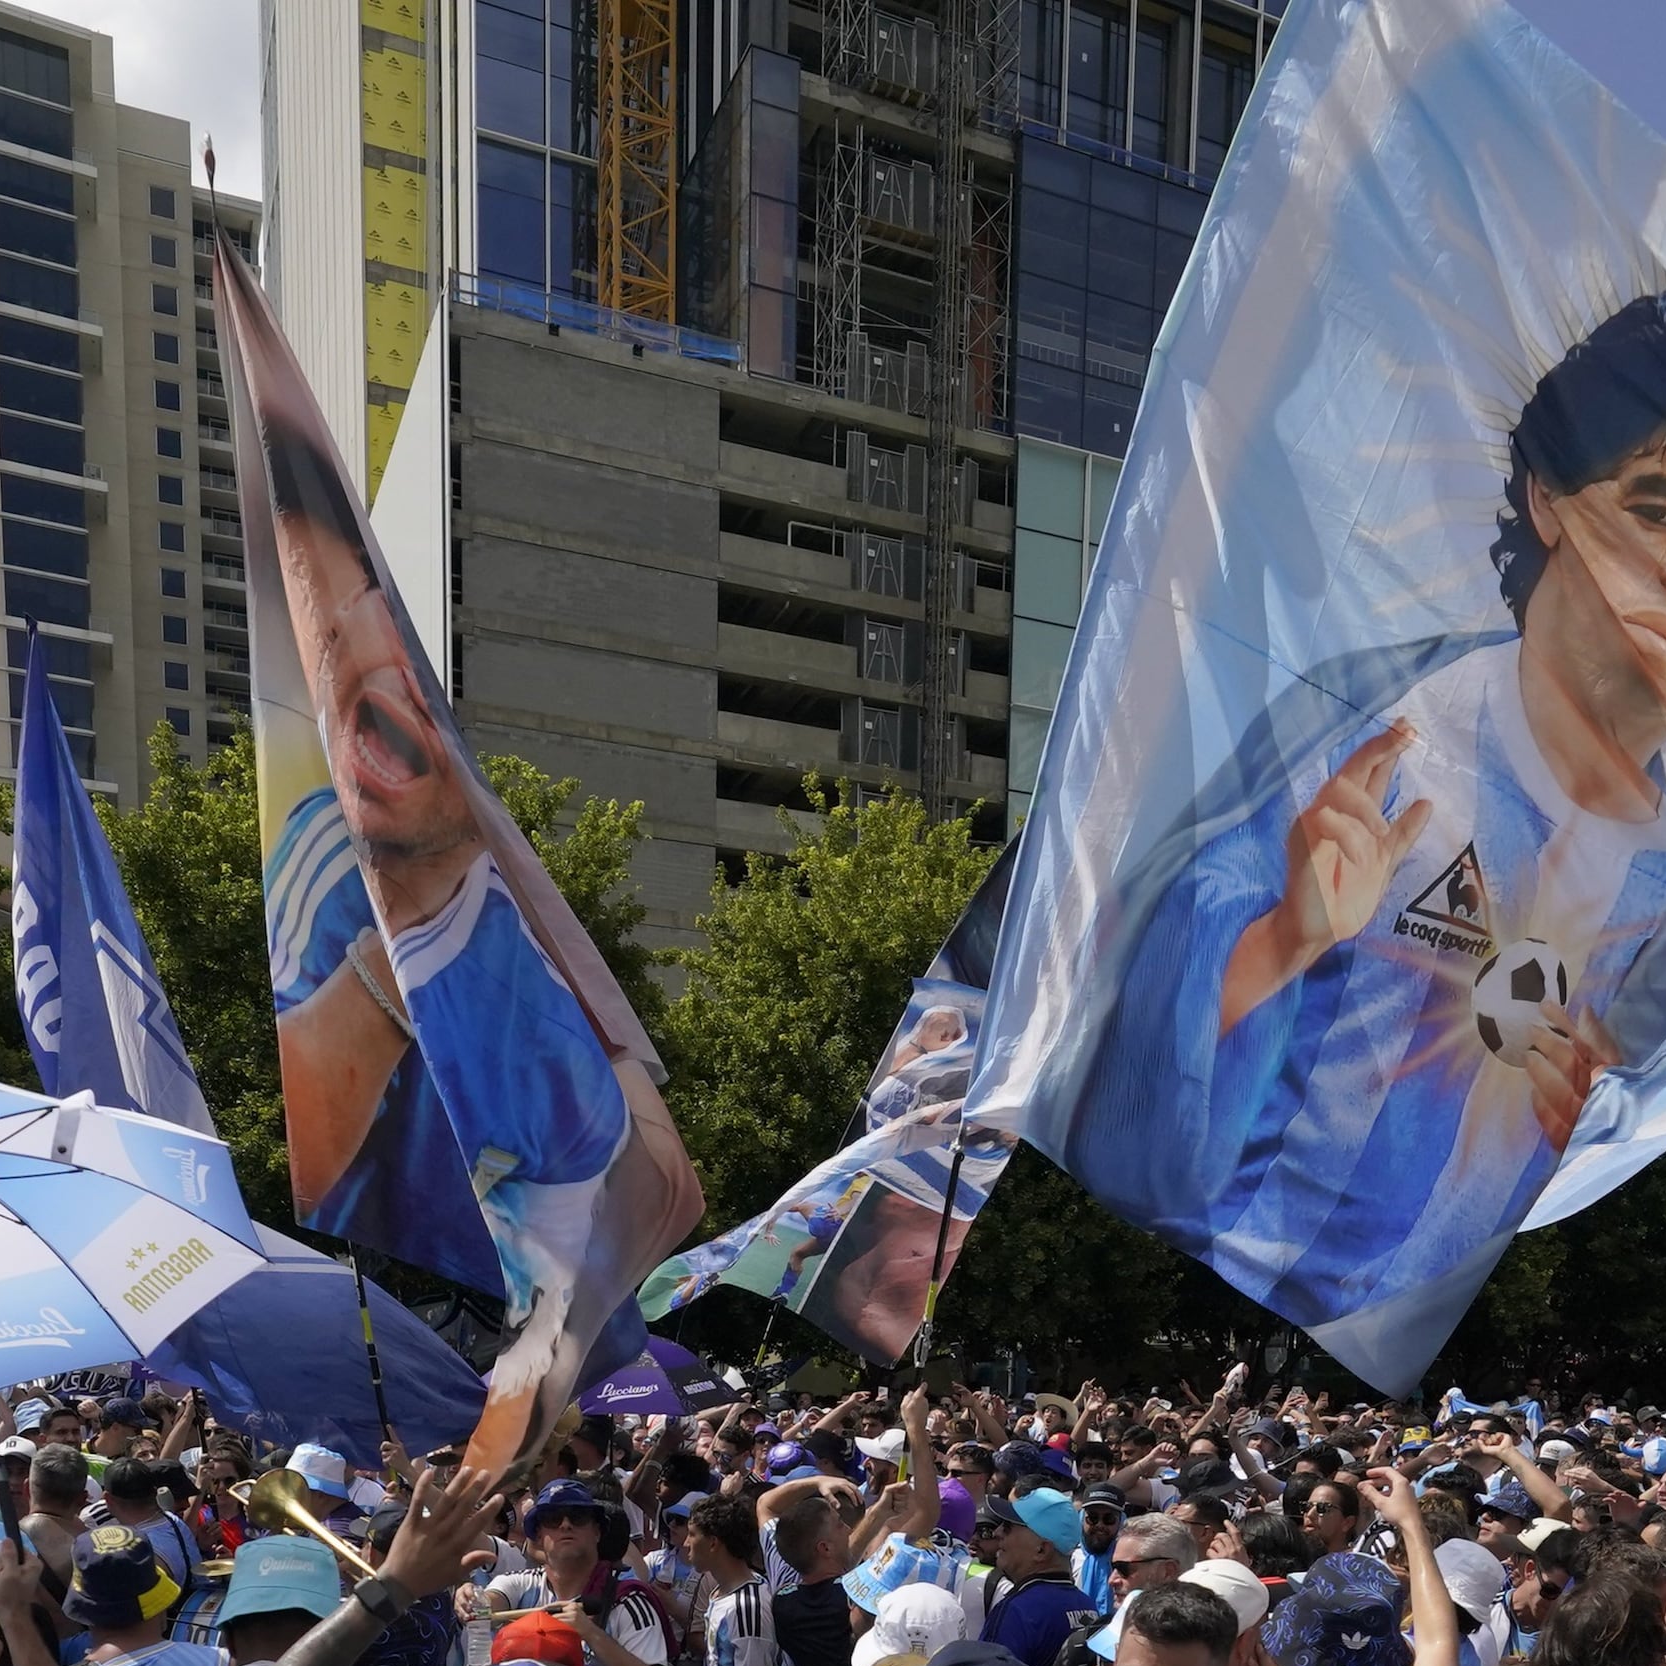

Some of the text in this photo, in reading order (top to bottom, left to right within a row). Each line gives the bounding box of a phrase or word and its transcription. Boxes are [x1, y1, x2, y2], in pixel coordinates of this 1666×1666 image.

[1393, 911, 1492, 958] le coq sportif
[259, 1556, 318, 1576] Quilmes
